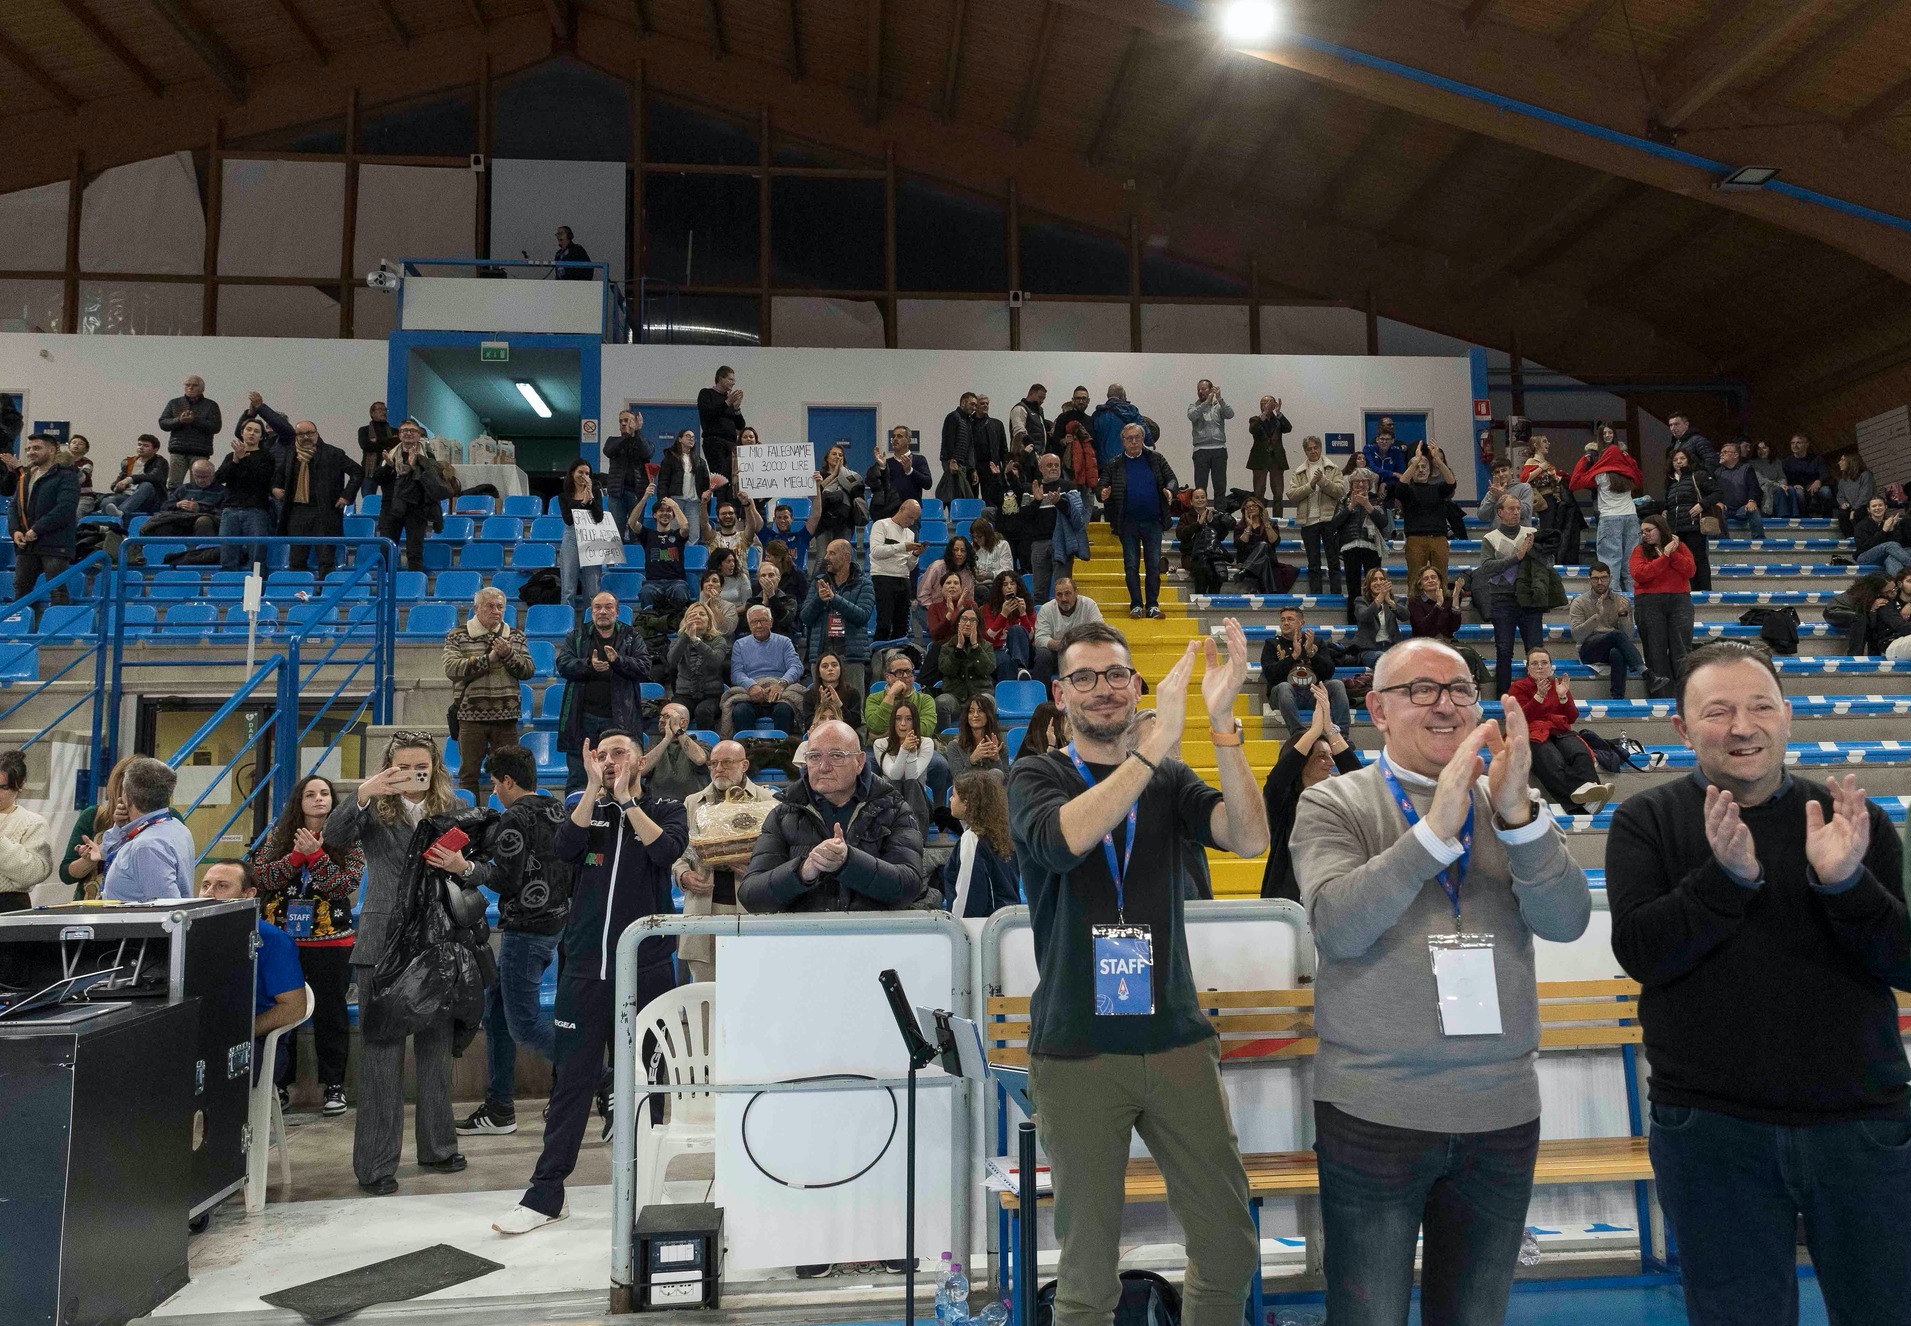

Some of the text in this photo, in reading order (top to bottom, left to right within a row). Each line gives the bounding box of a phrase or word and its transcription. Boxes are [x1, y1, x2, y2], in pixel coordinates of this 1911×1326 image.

[749, 446, 763, 458] MIO
[767, 444, 812, 458] FALEGNAME
[739, 460, 809, 472] CON 30000 LIRE
[783, 476, 815, 489] MEGLIO
[590, 819, 610, 828] GEA
[289, 913, 311, 922] STAFF
[1099, 958, 1146, 975] STAFF
